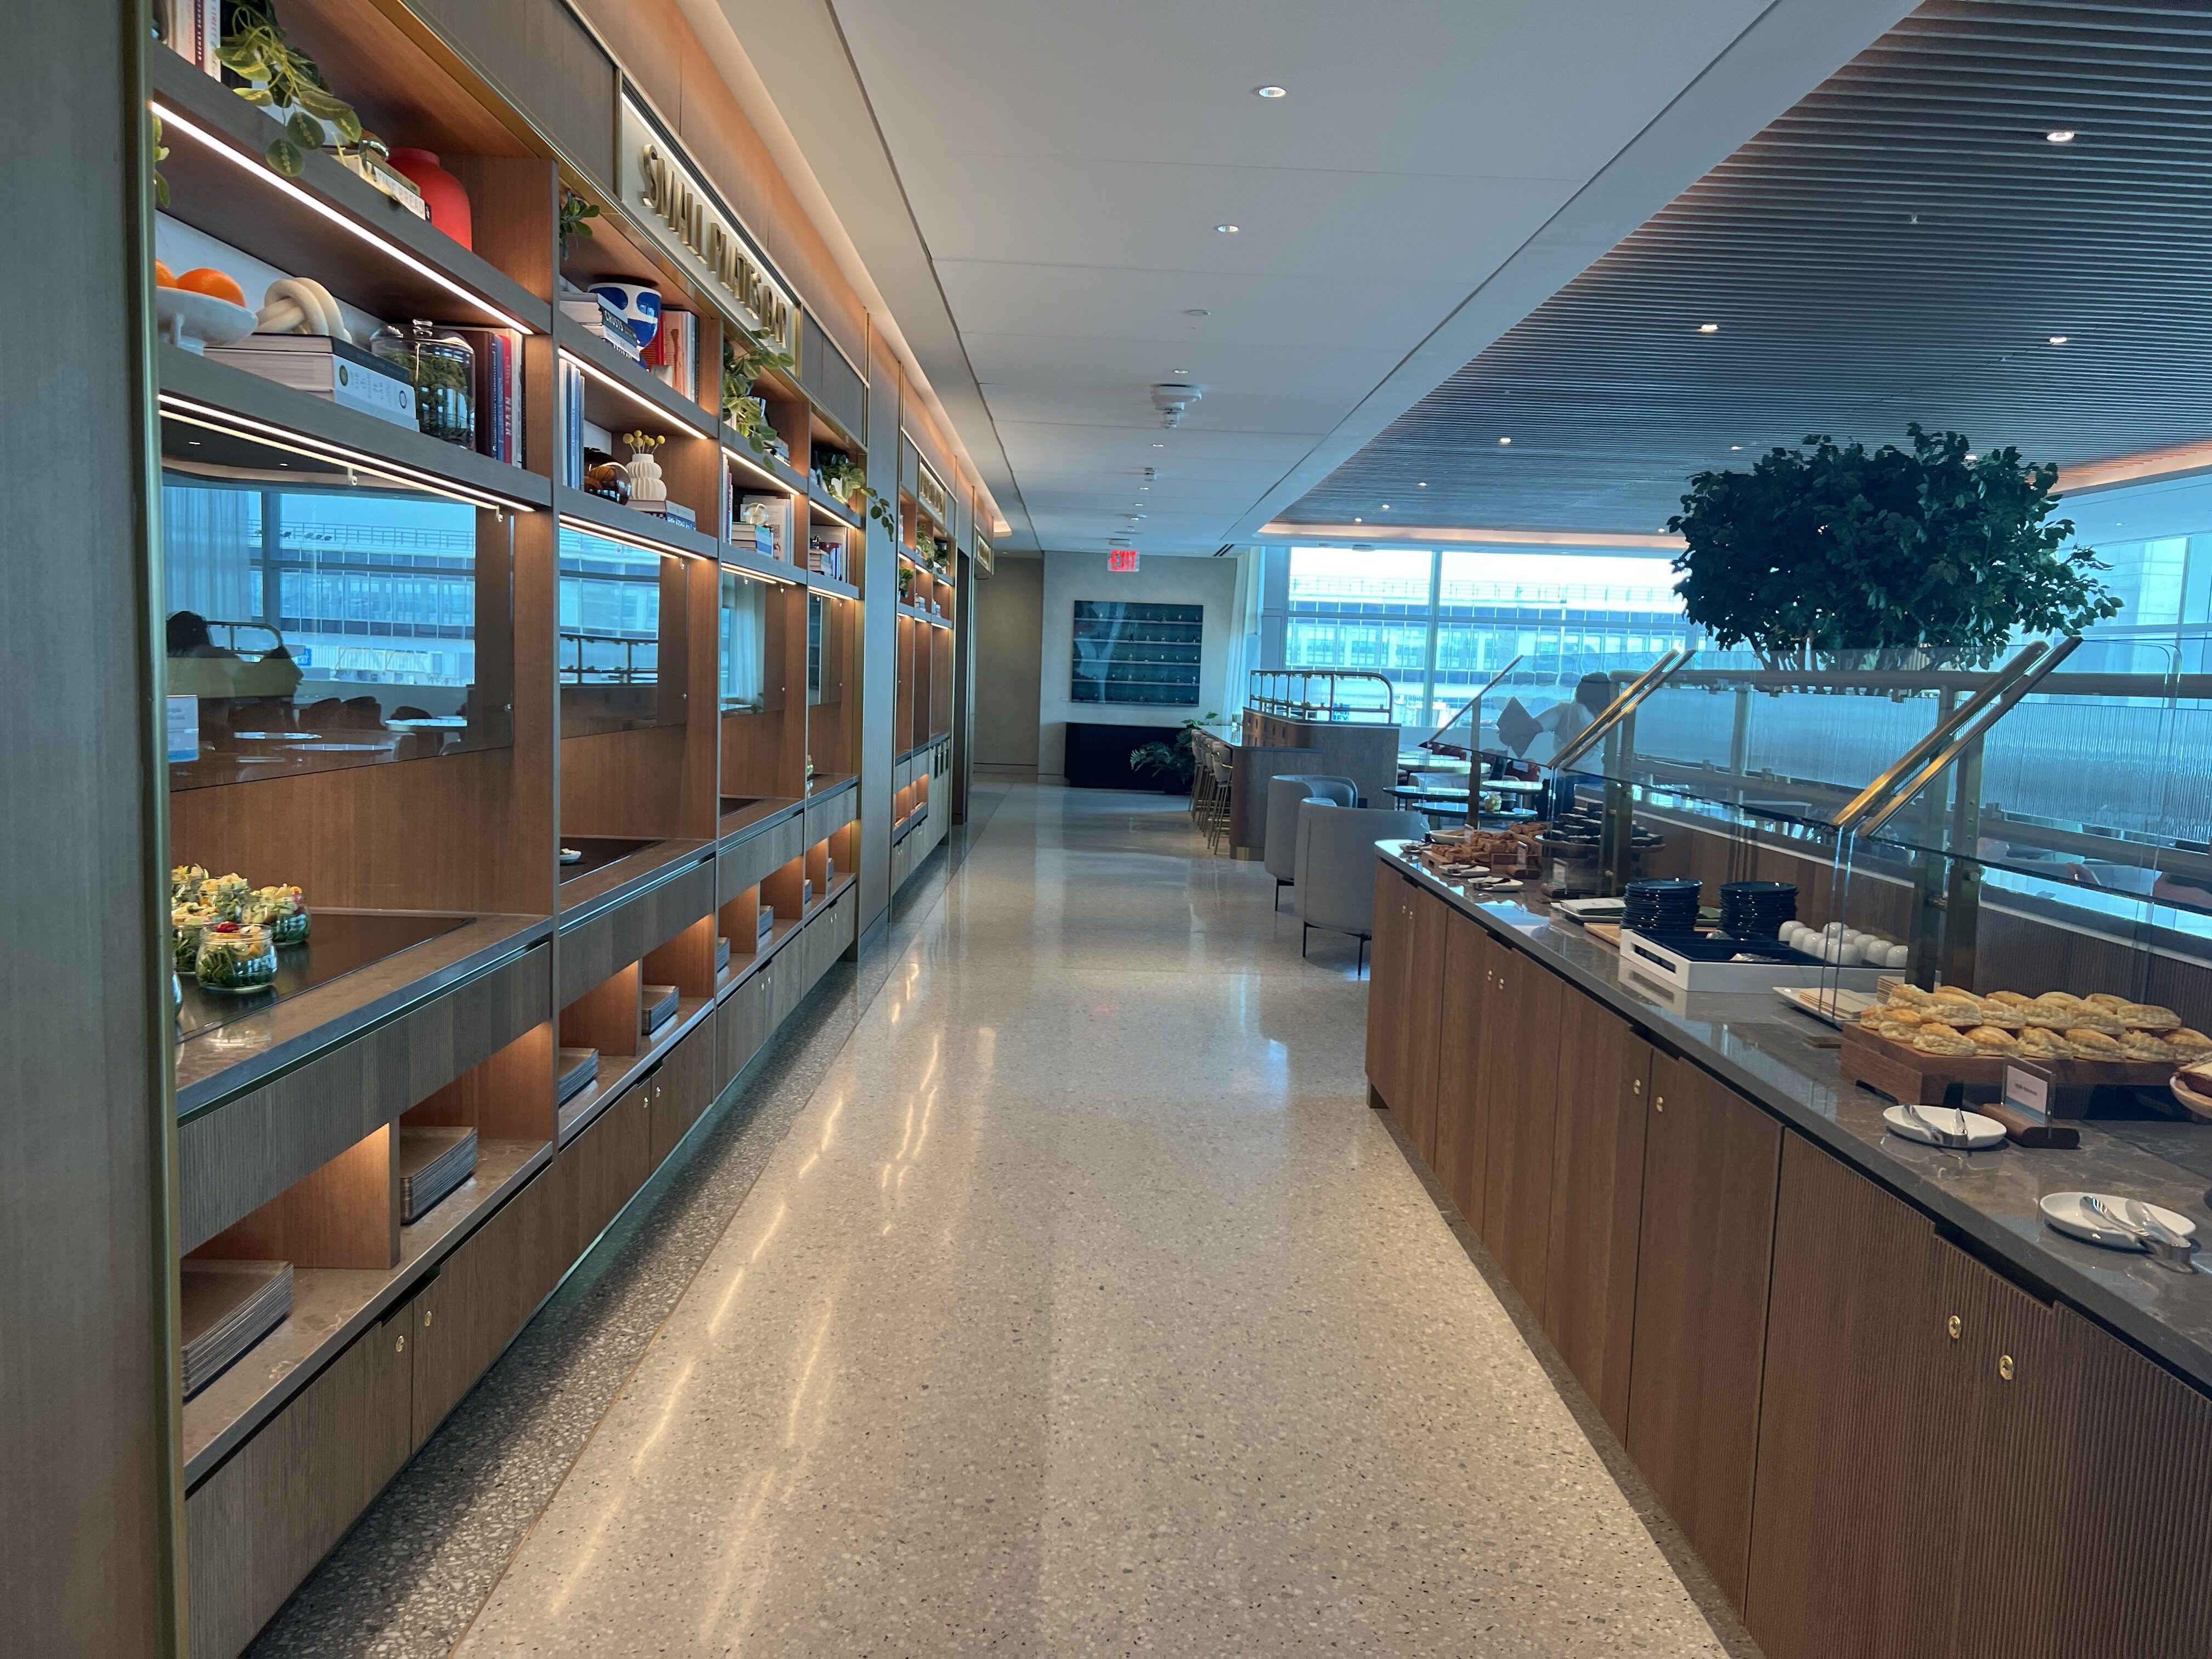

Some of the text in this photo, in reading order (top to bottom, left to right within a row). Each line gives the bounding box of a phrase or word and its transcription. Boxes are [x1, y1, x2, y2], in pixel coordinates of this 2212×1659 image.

[642, 144, 787, 349] SMALL PLATES BAR
[1111, 550, 1138, 571] EXIT
